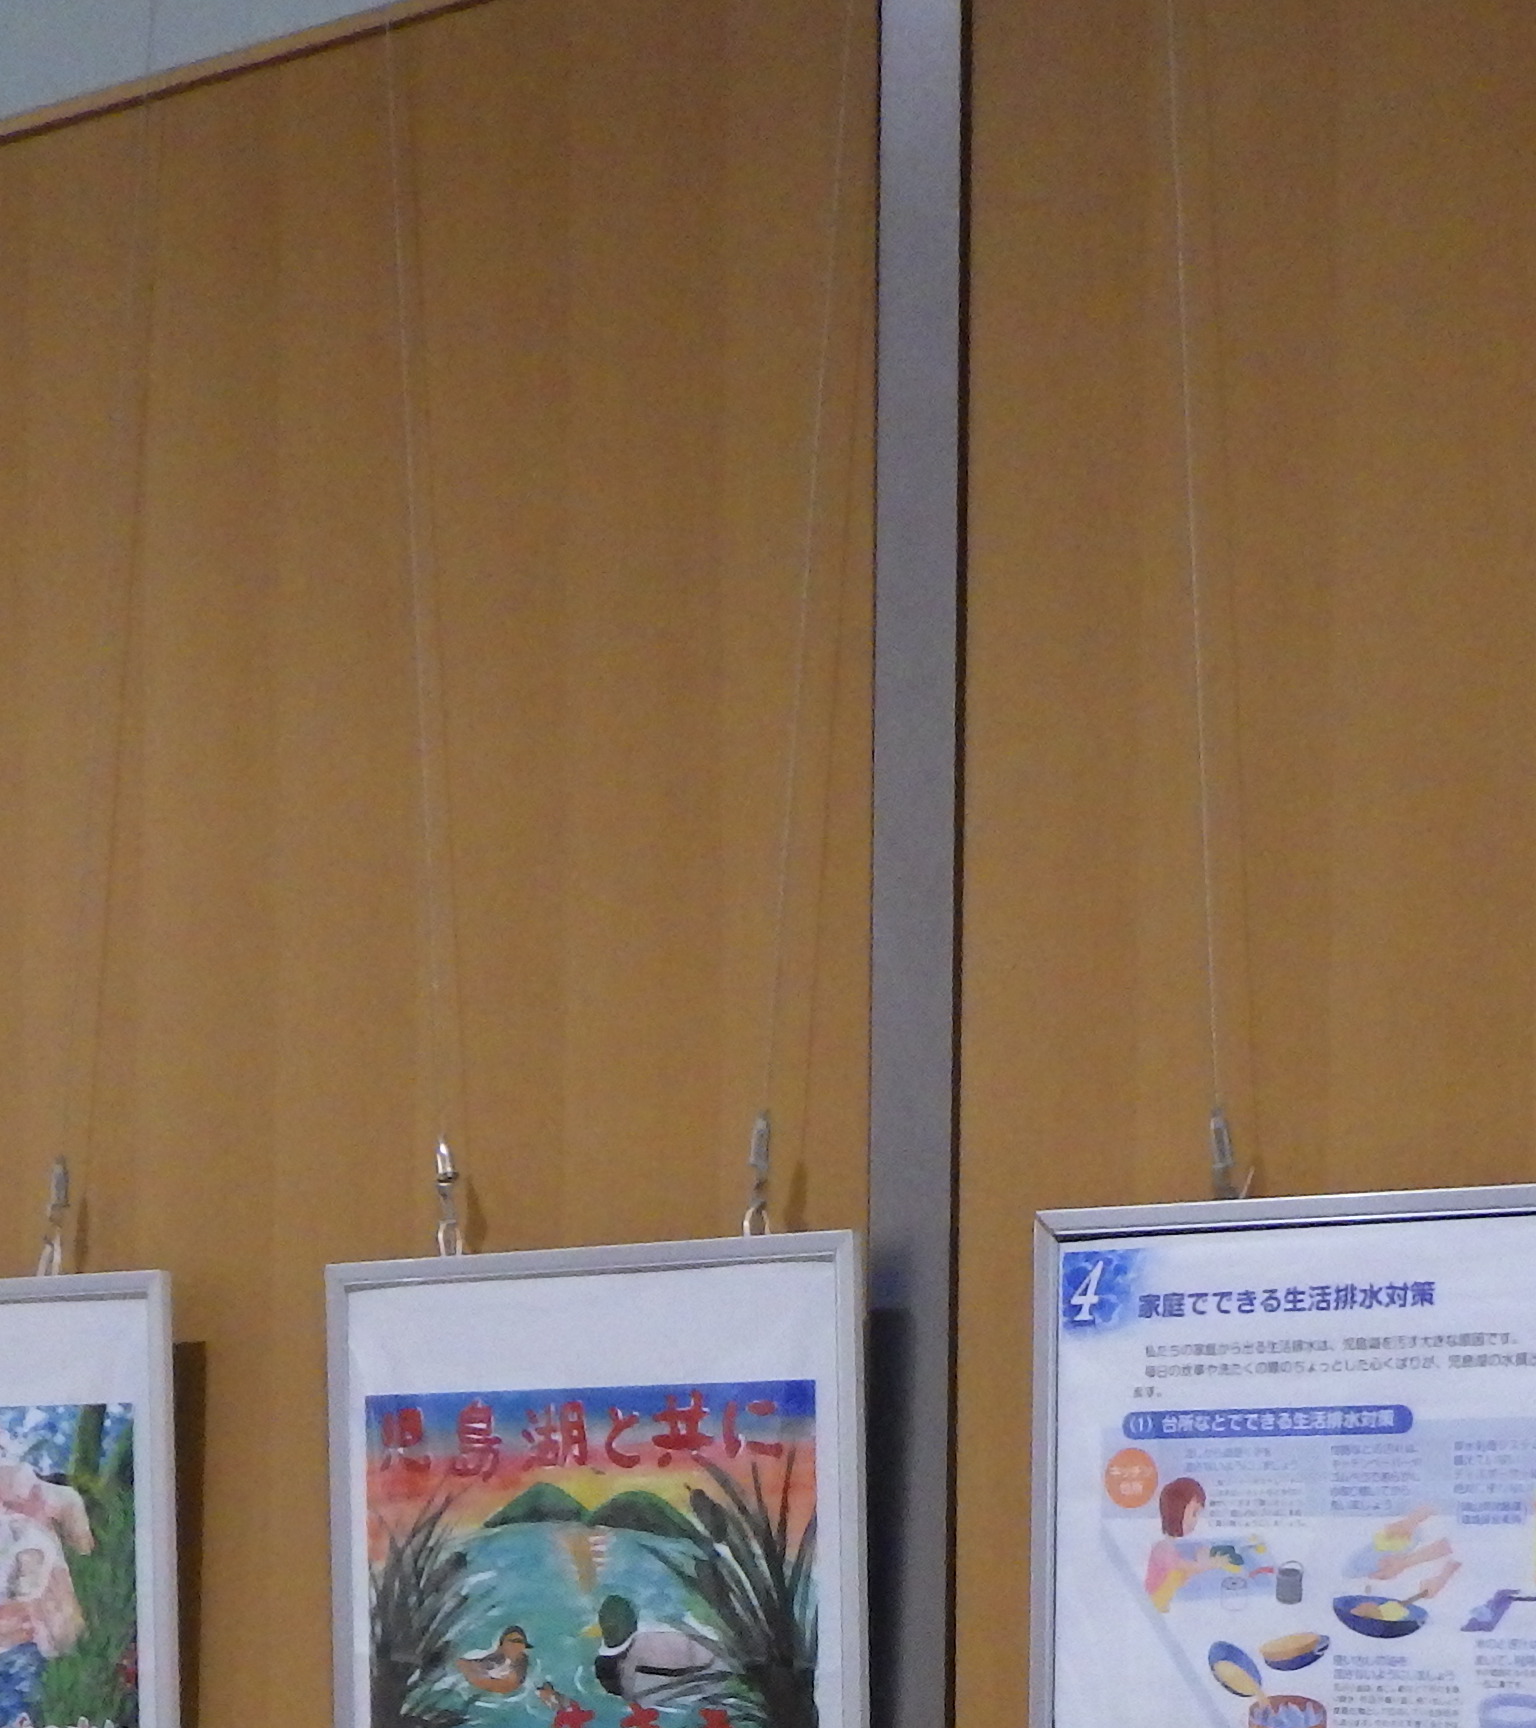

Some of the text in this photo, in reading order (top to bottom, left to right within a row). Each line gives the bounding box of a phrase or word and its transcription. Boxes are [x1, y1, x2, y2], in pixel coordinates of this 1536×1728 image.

[1070, 1260, 1104, 1321] 4
[1138, 1281, 1435, 1319] 家庭でできる生活排水対策
[381, 1389, 782, 1482] 児島湖と共に
